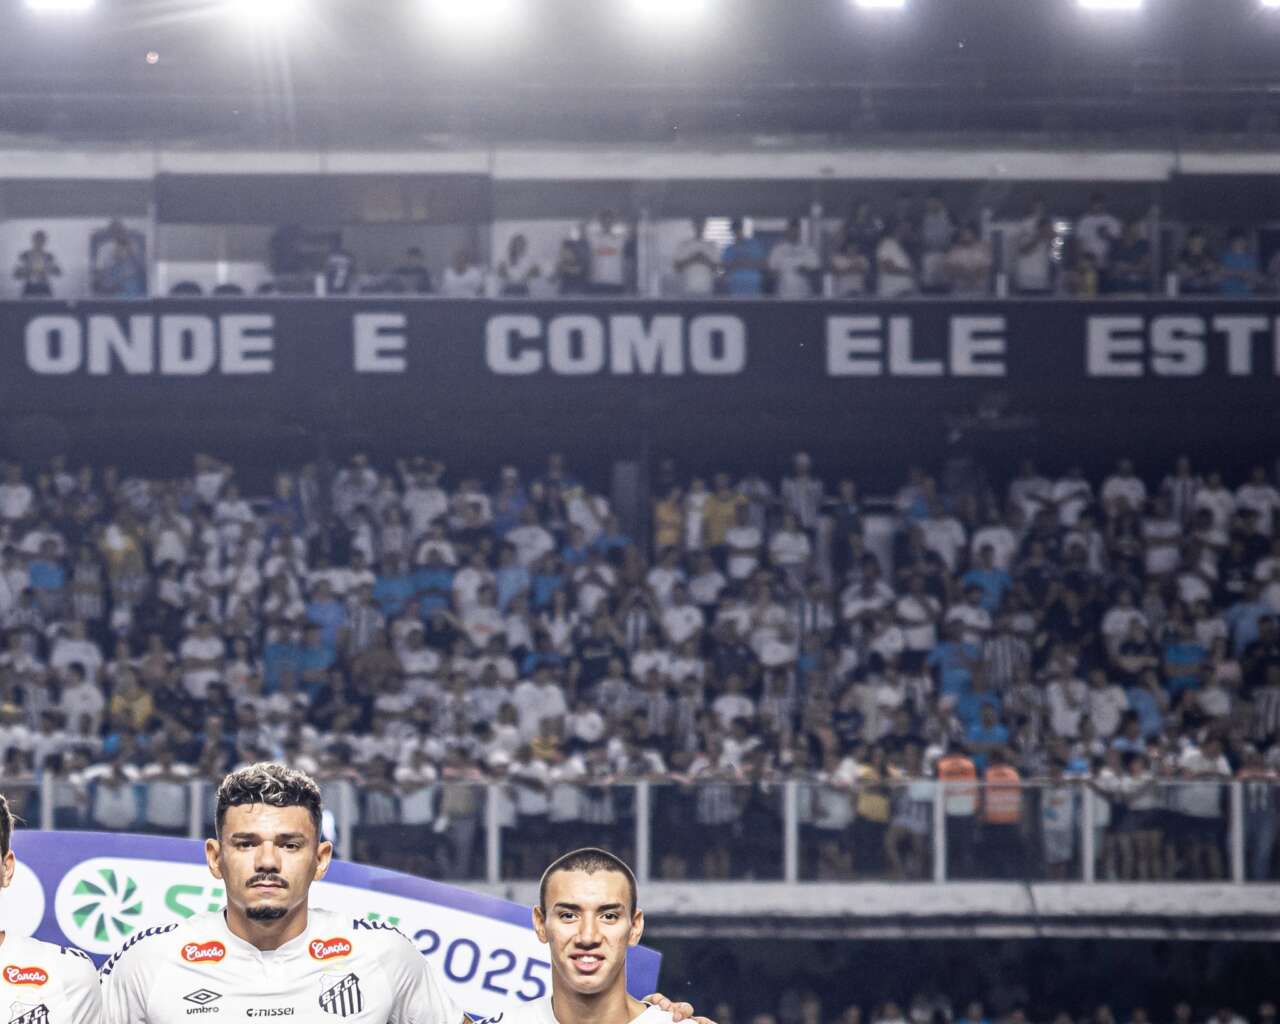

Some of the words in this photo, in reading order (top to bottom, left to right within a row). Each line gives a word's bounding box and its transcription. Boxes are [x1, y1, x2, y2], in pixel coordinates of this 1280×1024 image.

[25, 313, 275, 376] ONDE
[353, 313, 408, 374] E
[485, 313, 748, 376] COMO
[826, 314, 1007, 376] ELE
[1086, 313, 1280, 376] EST
[186, 1006, 220, 1015] umbro
